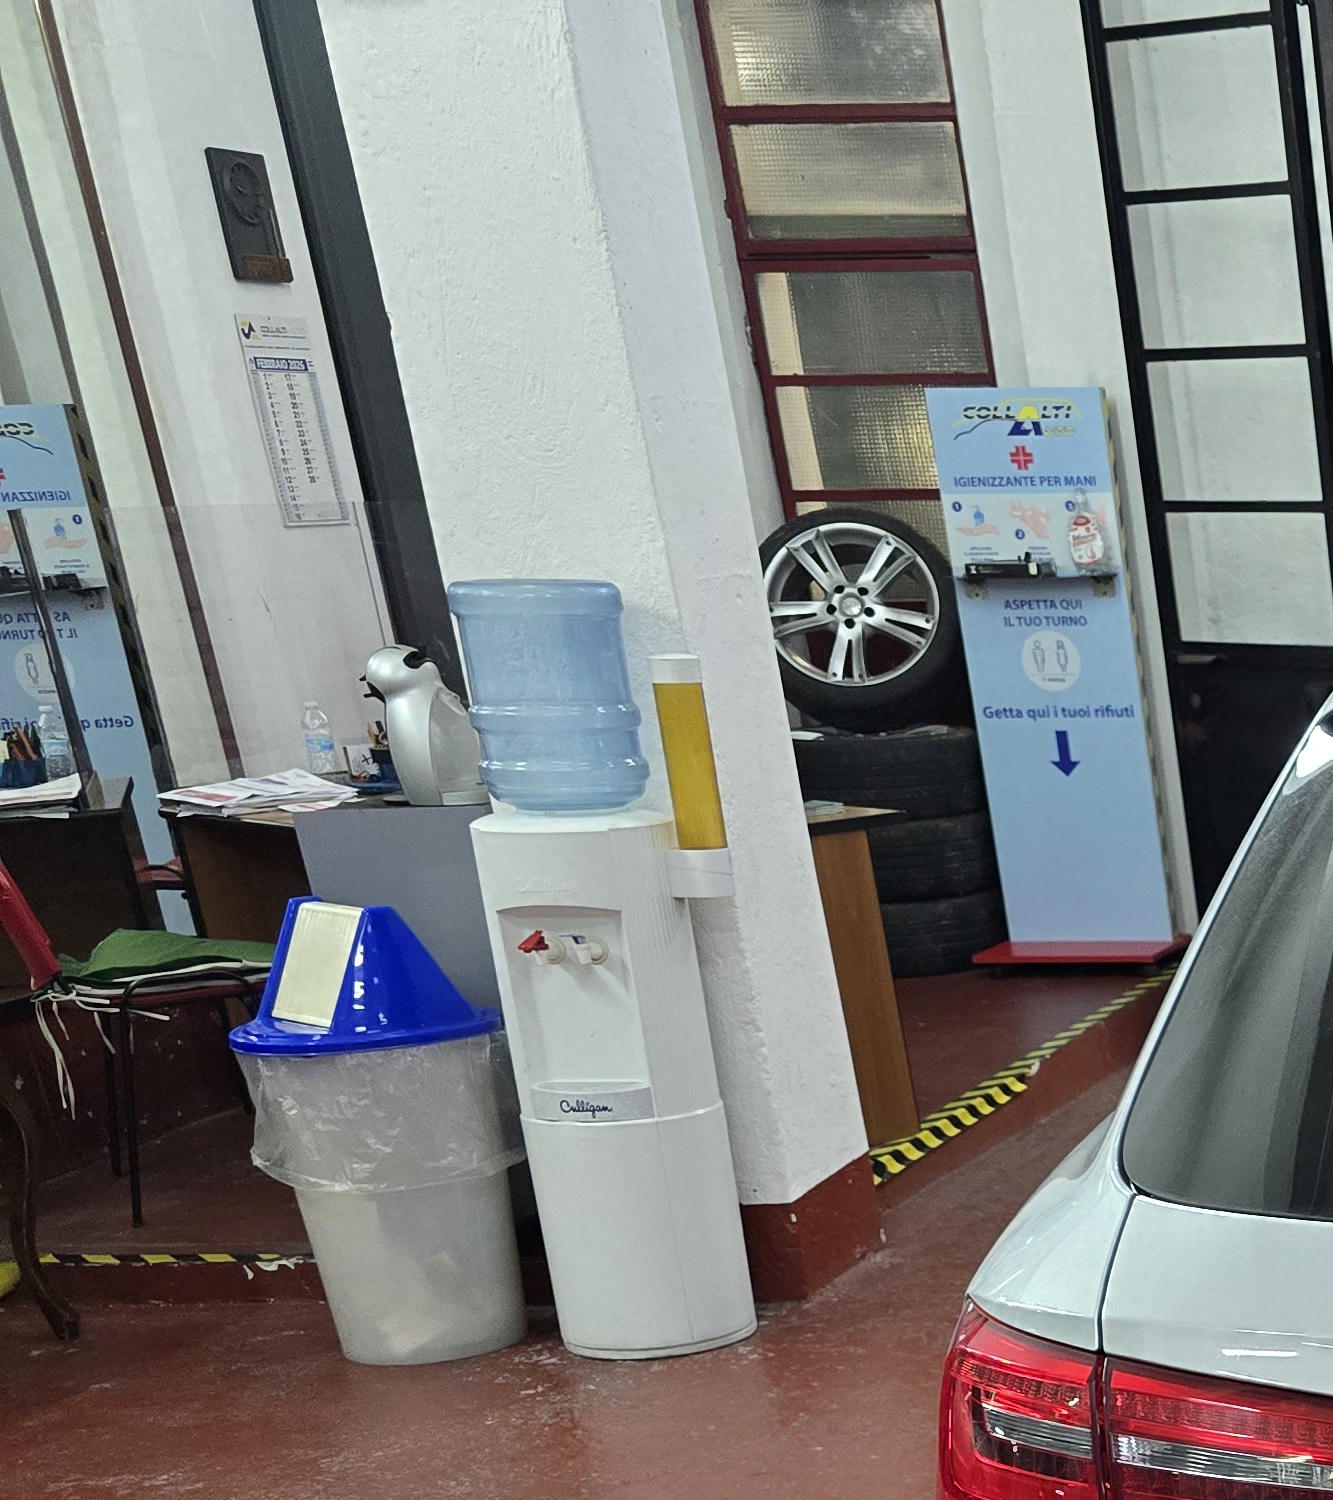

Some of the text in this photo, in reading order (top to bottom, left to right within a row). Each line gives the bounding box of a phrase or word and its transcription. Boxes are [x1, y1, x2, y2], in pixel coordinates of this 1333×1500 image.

[954, 476, 1097, 487] IGIENIZZANTE PER MANI
[1004, 599, 1083, 611] ASPETTA QUI
[1003, 616, 1087, 627] IL TUO TURNO
[983, 706, 1024, 719] Getta
[1026, 705, 1050, 722] qui
[1060, 705, 1091, 718] tuoi
[1094, 704, 1135, 718] rifiuti
[560, 1099, 612, 1118] Culligan
